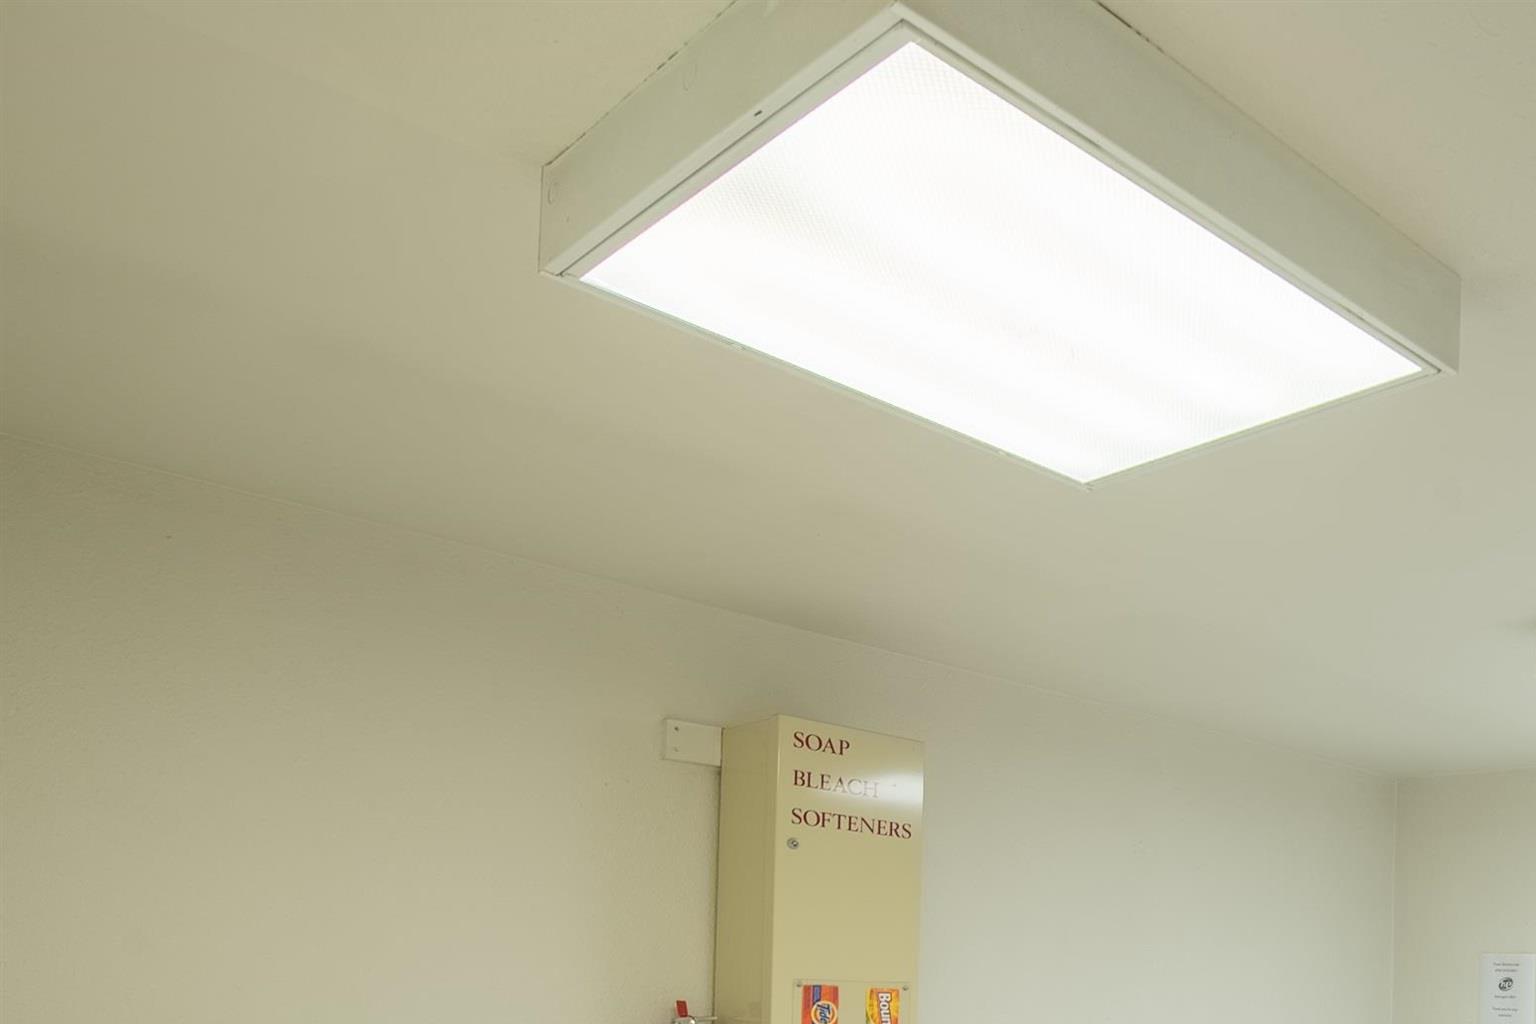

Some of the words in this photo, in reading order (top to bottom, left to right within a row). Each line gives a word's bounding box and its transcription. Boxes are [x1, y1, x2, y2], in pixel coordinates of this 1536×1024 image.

[793, 731, 850, 756] SOAP
[793, 769, 880, 798] BLEACH
[791, 807, 912, 839] SOFTENERS
[816, 1003, 831, 1024] Tide
